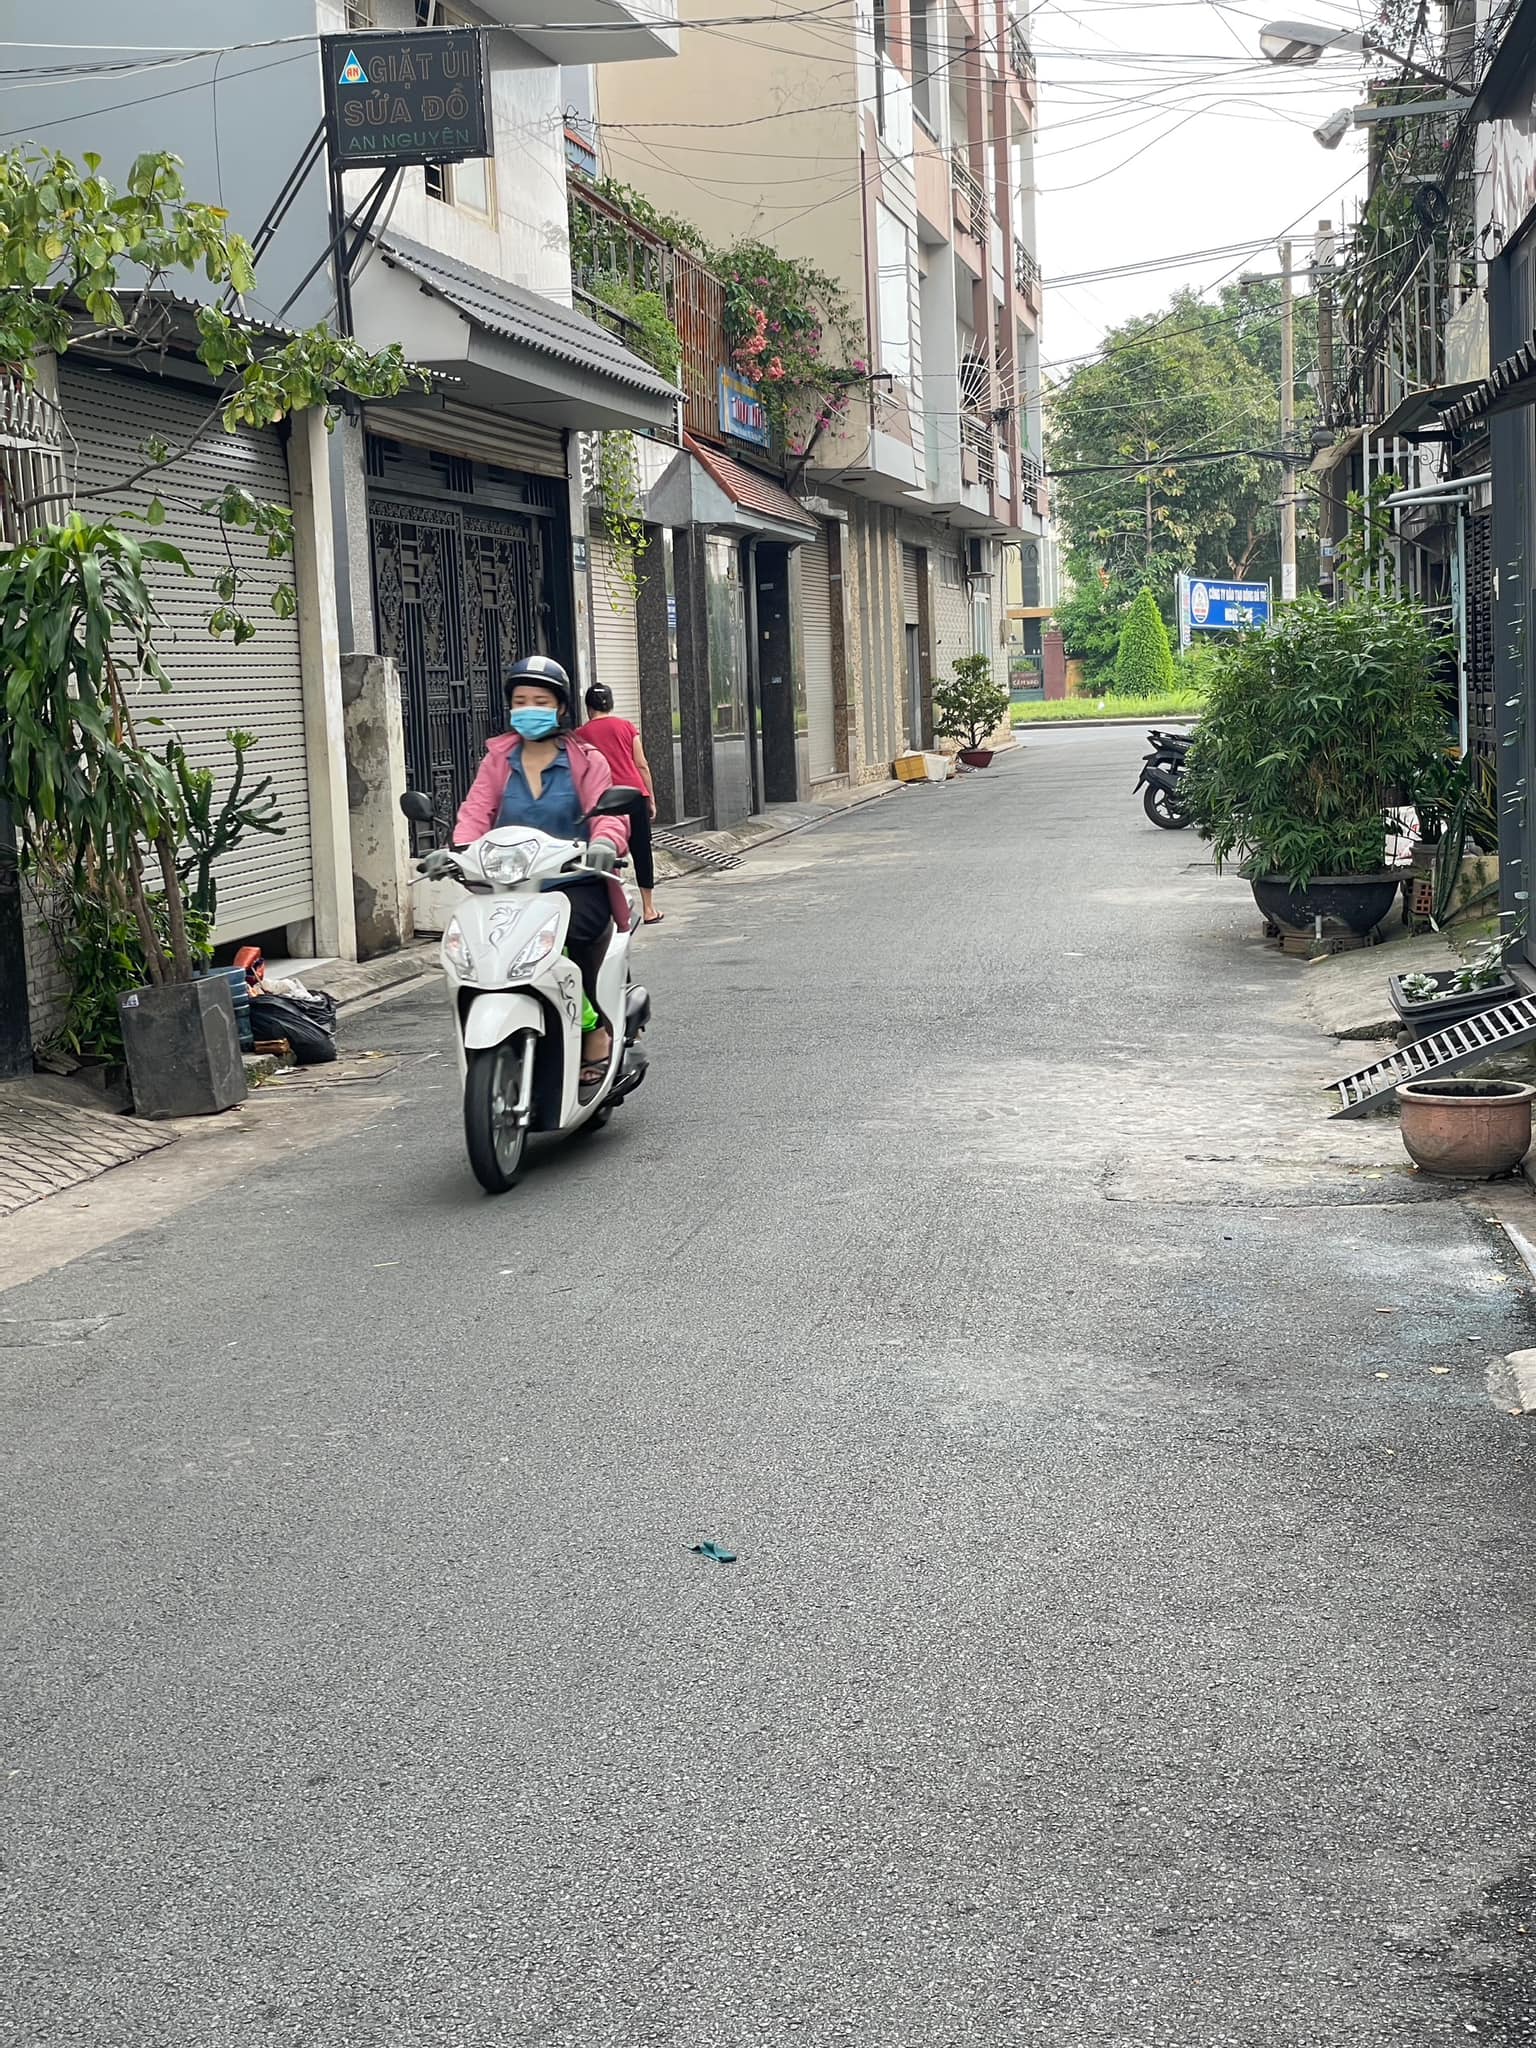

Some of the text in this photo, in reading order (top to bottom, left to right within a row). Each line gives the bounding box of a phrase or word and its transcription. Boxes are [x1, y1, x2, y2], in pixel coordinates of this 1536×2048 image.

[346, 66, 359, 78] AN
[368, 41, 471, 90] GIẶT ỦI
[344, 83, 469, 127] SỬA ĐỒ
[349, 127, 469, 151] AN NGUYÊN
